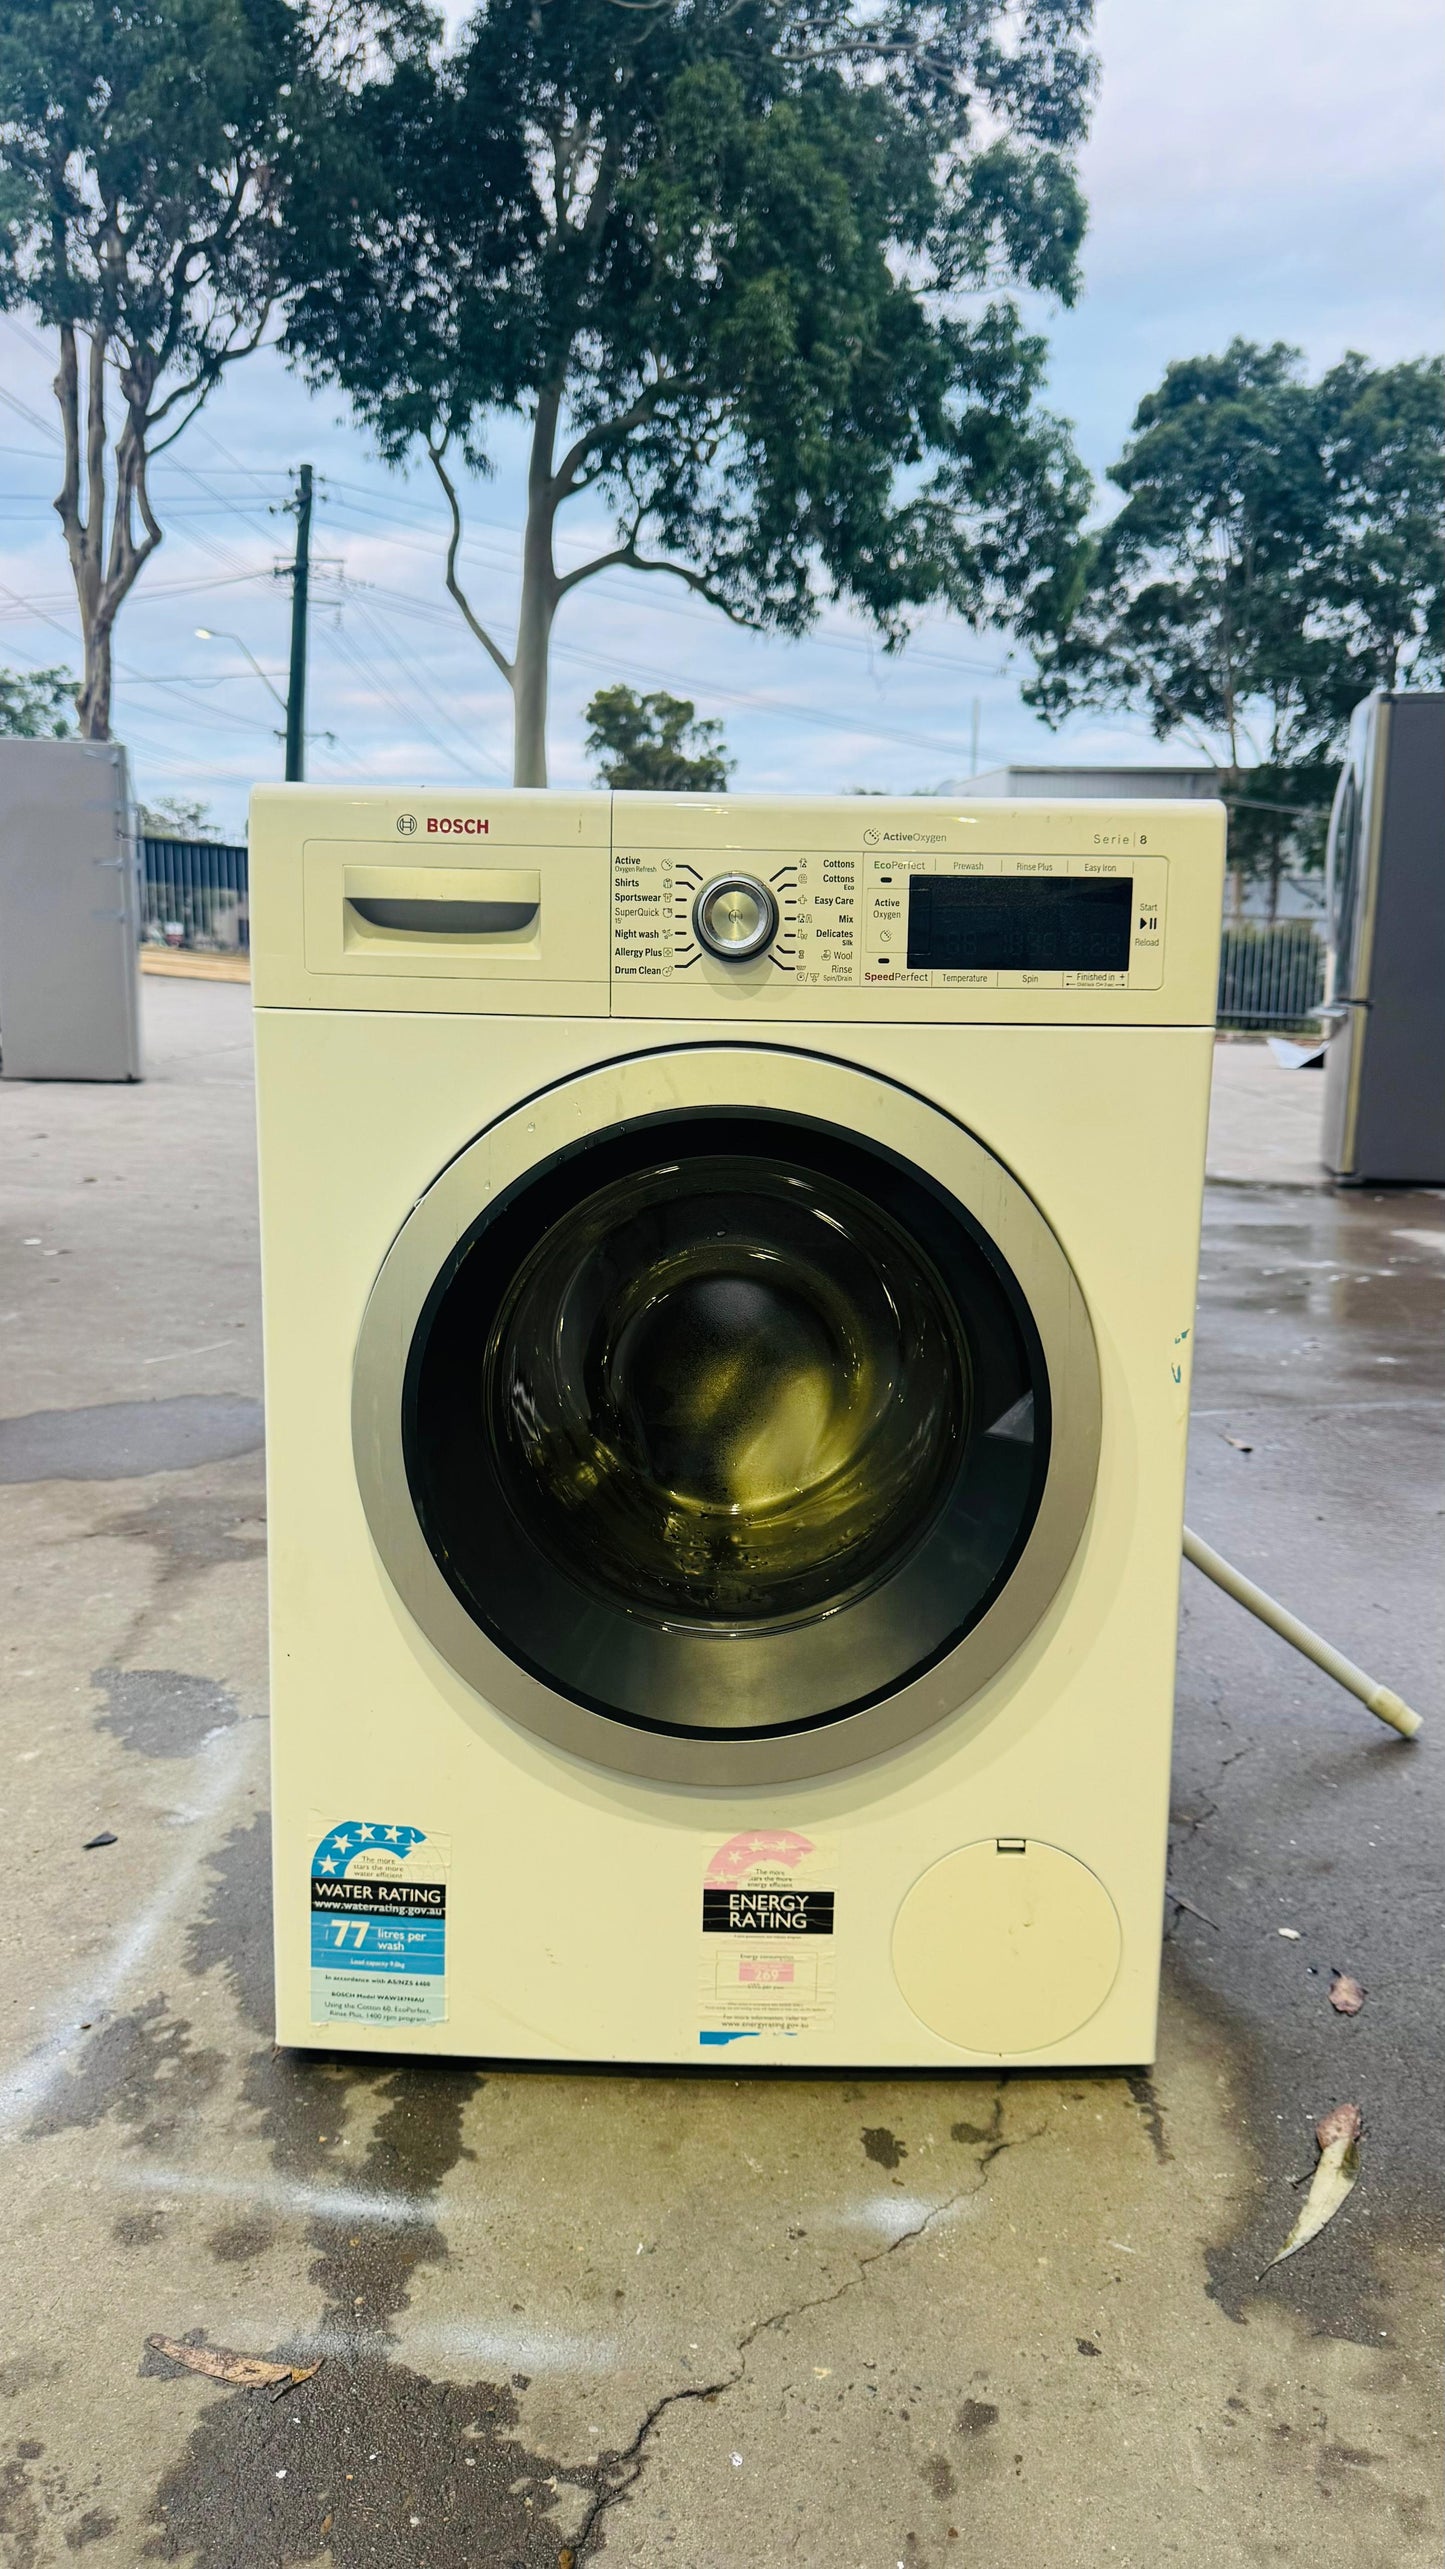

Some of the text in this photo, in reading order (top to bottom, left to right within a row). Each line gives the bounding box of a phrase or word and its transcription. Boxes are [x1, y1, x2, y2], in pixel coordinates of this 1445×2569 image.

[426, 818, 489, 834] BOSCH
[883, 832, 947, 843] ActiveOxygen
[1093, 834, 1147, 844] Serie 8
[615, 856, 641, 865] Active
[823, 859, 855, 868] Cottons
[874, 861, 926, 870] EcoPerfect
[953, 861, 984, 870] Prewash
[1016, 862, 1053, 872] Rinse Plus
[1084, 863, 1117, 873] Easy Iron
[615, 878, 640, 887] Shirts
[823, 874, 855, 883] Cottons
[615, 893, 661, 903] Sportswear
[814, 896, 854, 906] Easy Care
[874, 898, 900, 907] Active
[615, 907, 659, 917] SuperQuick
[1139, 903, 1158, 912] Start
[838, 914, 854, 923] Mix
[873, 910, 901, 920] Oxygen
[615, 929, 659, 939] Night wash
[816, 929, 854, 938] Delicates
[1135, 938, 1160, 947] Reload
[615, 947, 662, 958] Allergy Plus
[833, 951, 853, 960] Wool
[615, 966, 661, 975] Drum Clean
[831, 965, 853, 974] Rinse
[864, 972, 929, 982] SpeedPerfect
[943, 973, 988, 983] Temperature
[1022, 974, 1039, 983] Spin
[1076, 972, 1116, 982] Finished in
[361, 1855, 376, 1864] The
[315, 1882, 441, 1904] WATER RATING
[729, 1893, 809, 1912] ENERGY
[314, 1900, 442, 1916] www.waterrating.gov.au
[729, 1911, 808, 1929] RATING
[331, 1919, 370, 1949] 77
[378, 1928, 427, 1943] litres per
[377, 1941, 405, 1951] wash
